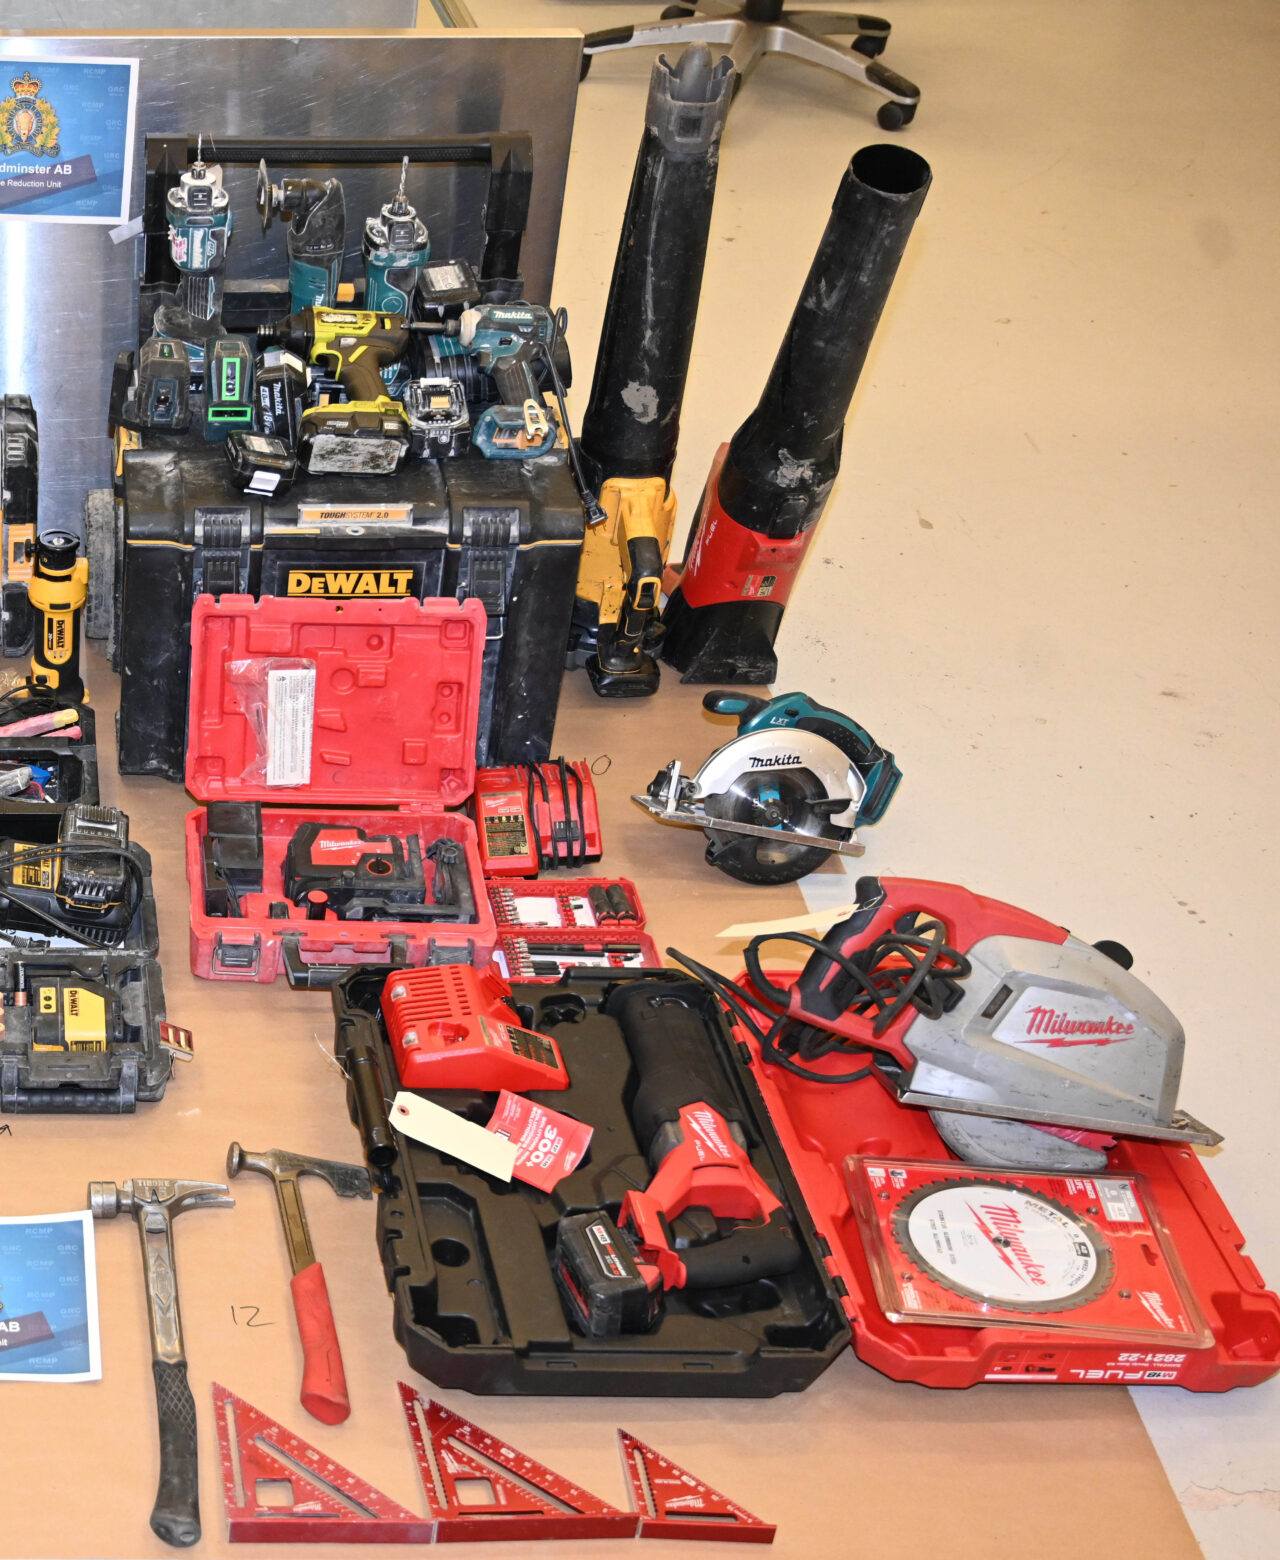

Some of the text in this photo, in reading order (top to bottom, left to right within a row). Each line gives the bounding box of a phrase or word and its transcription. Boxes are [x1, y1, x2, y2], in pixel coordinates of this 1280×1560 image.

[54, 164, 72, 175] AB
[7, 179, 45, 188] Reduction
[47, 181, 62, 189] Unit
[494, 310, 533, 319] Makita
[320, 511, 389, 519] TOUGHSYSTEM 2.0
[287, 572, 414, 594] DEWALT
[56, 620, 65, 648] DEWALT
[770, 716, 790, 726] LXT
[69, 990, 78, 1016] DEWALT
[1025, 1005, 1137, 1035] Milwaukee
[692, 1109, 731, 1159] Milwaukee
[980, 1203, 1046, 1287] Milwaukee
[230, 1304, 277, 1327] 12
[1117, 1353, 1186, 1362] 2821-22
[1069, 1369, 1144, 1379] FUEL
